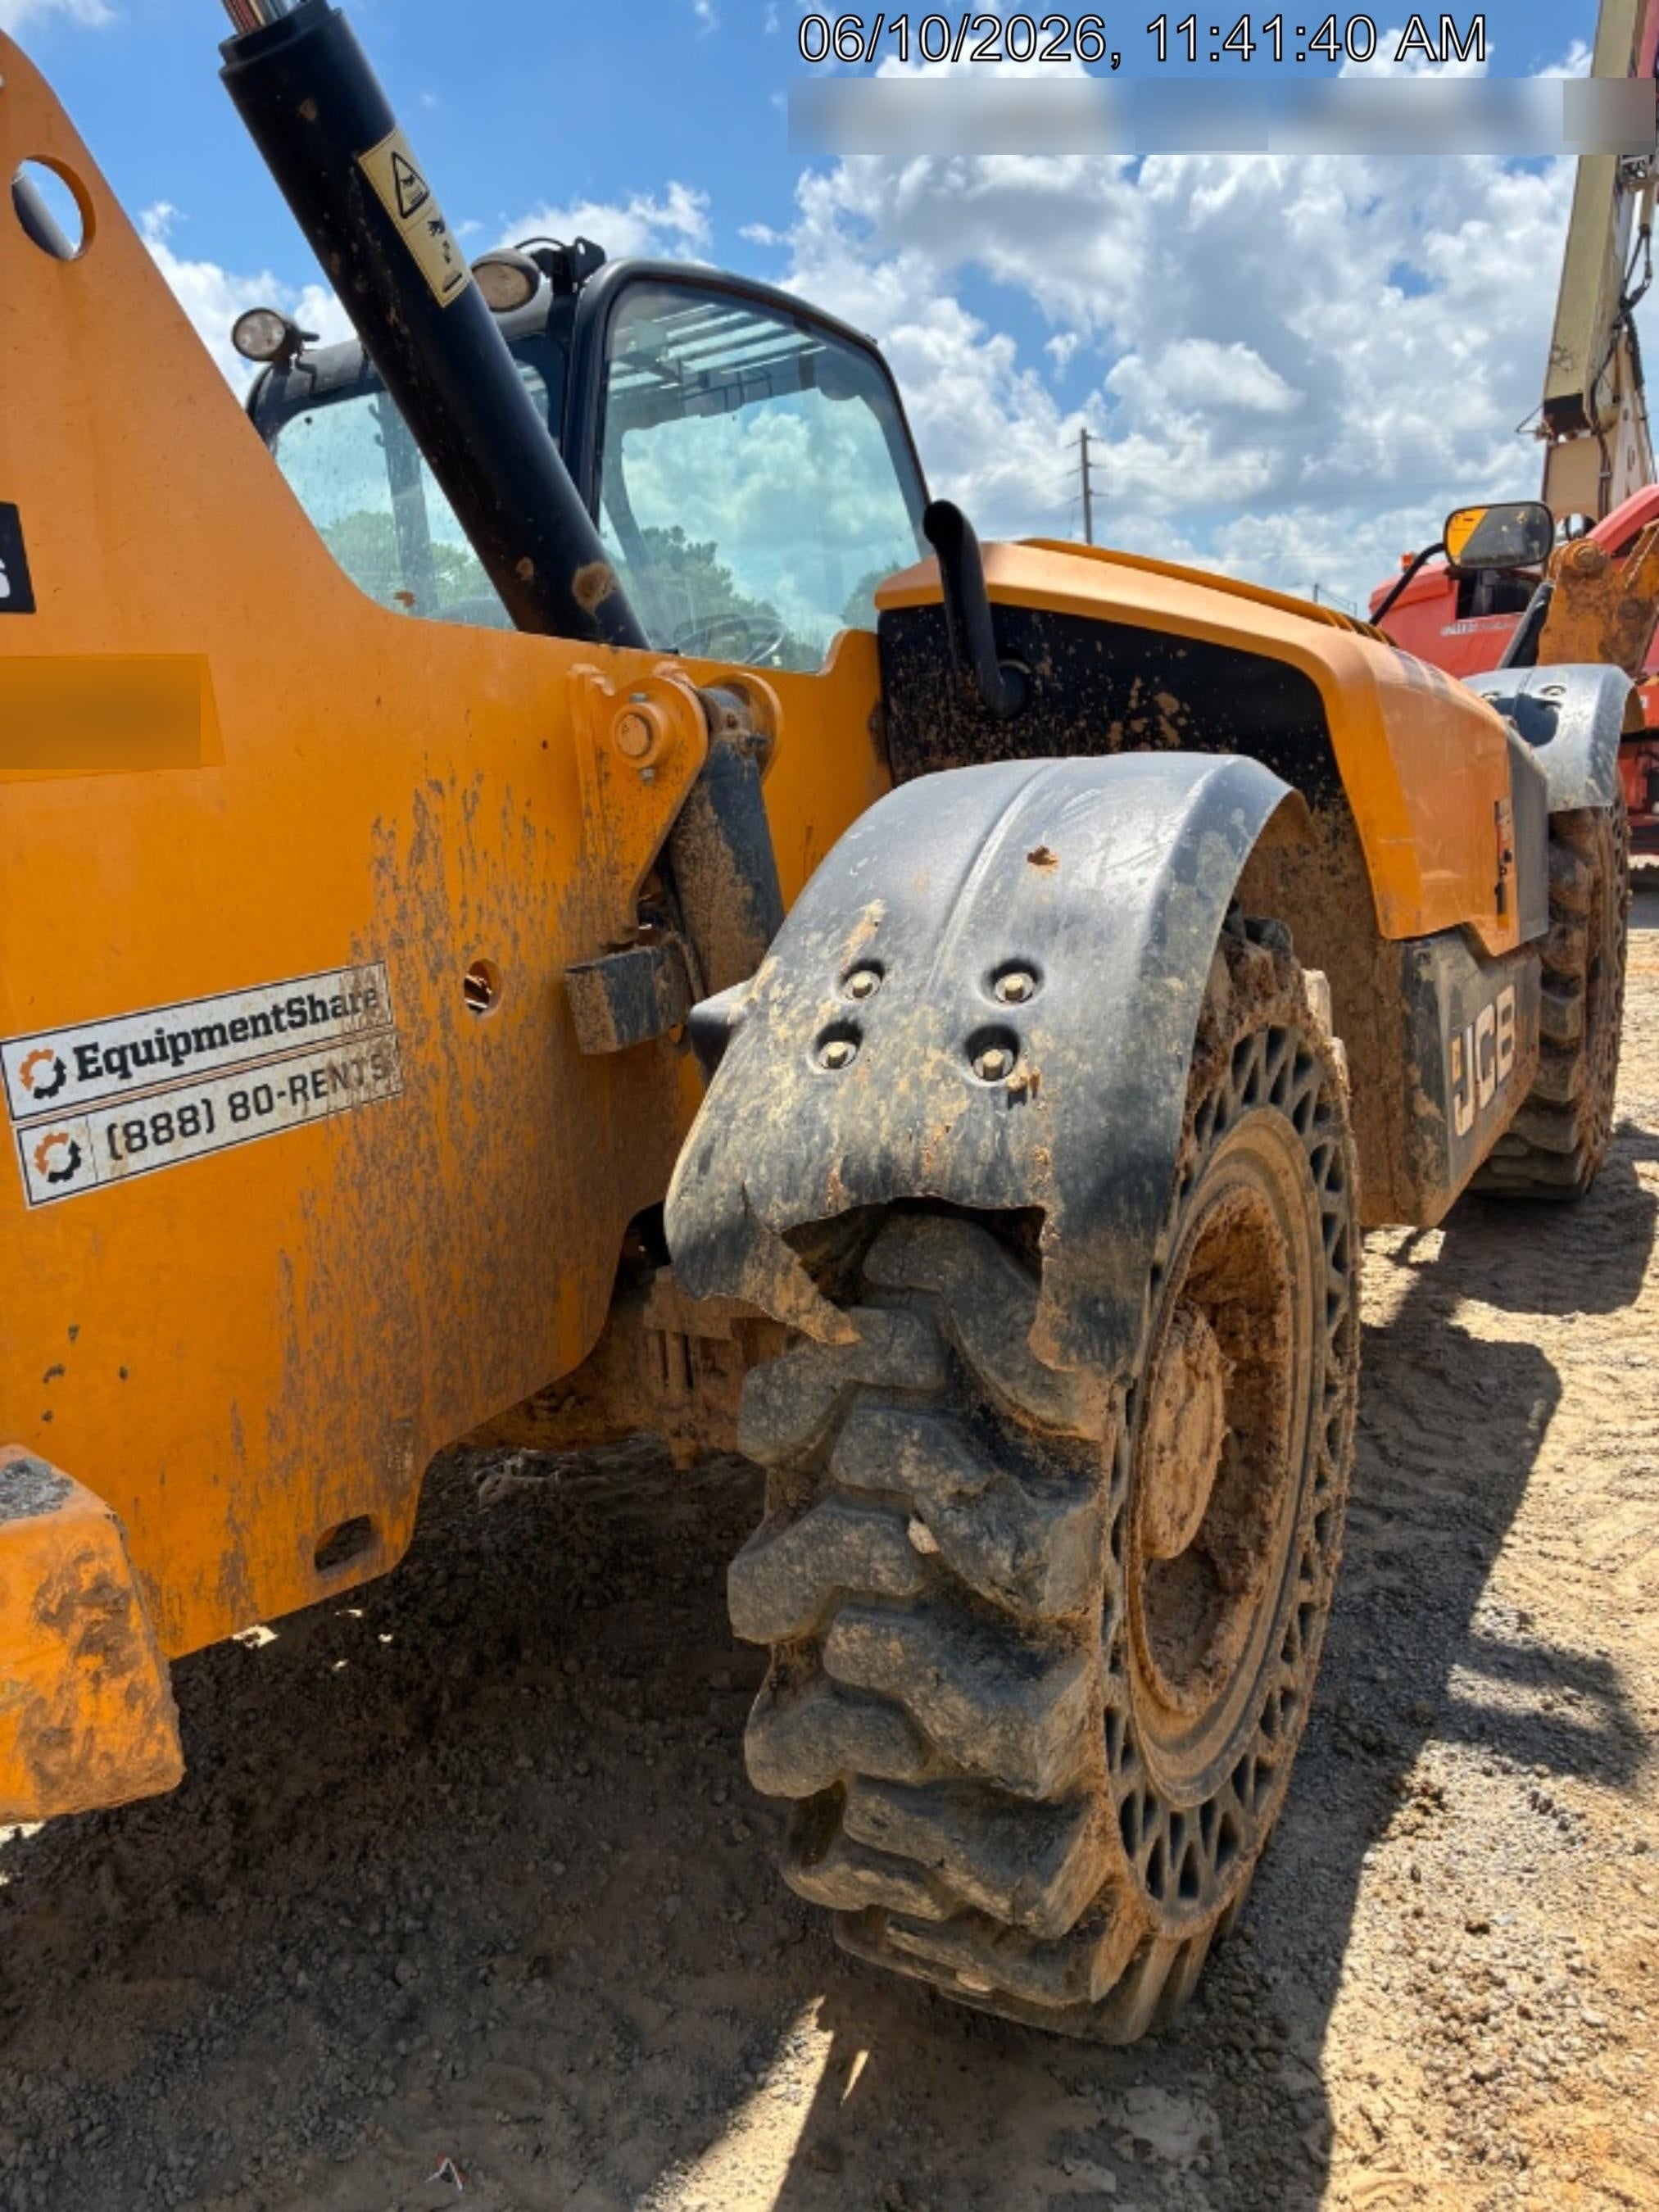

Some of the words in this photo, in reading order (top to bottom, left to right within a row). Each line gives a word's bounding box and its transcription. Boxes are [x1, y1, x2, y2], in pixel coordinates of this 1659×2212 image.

[72, 987, 378, 1081] EquipmentShare
[1452, 985, 1515, 1136] JCB
[107, 1099, 214, 1161] (888)
[229, 1054, 392, 1123] 80-RENTS
